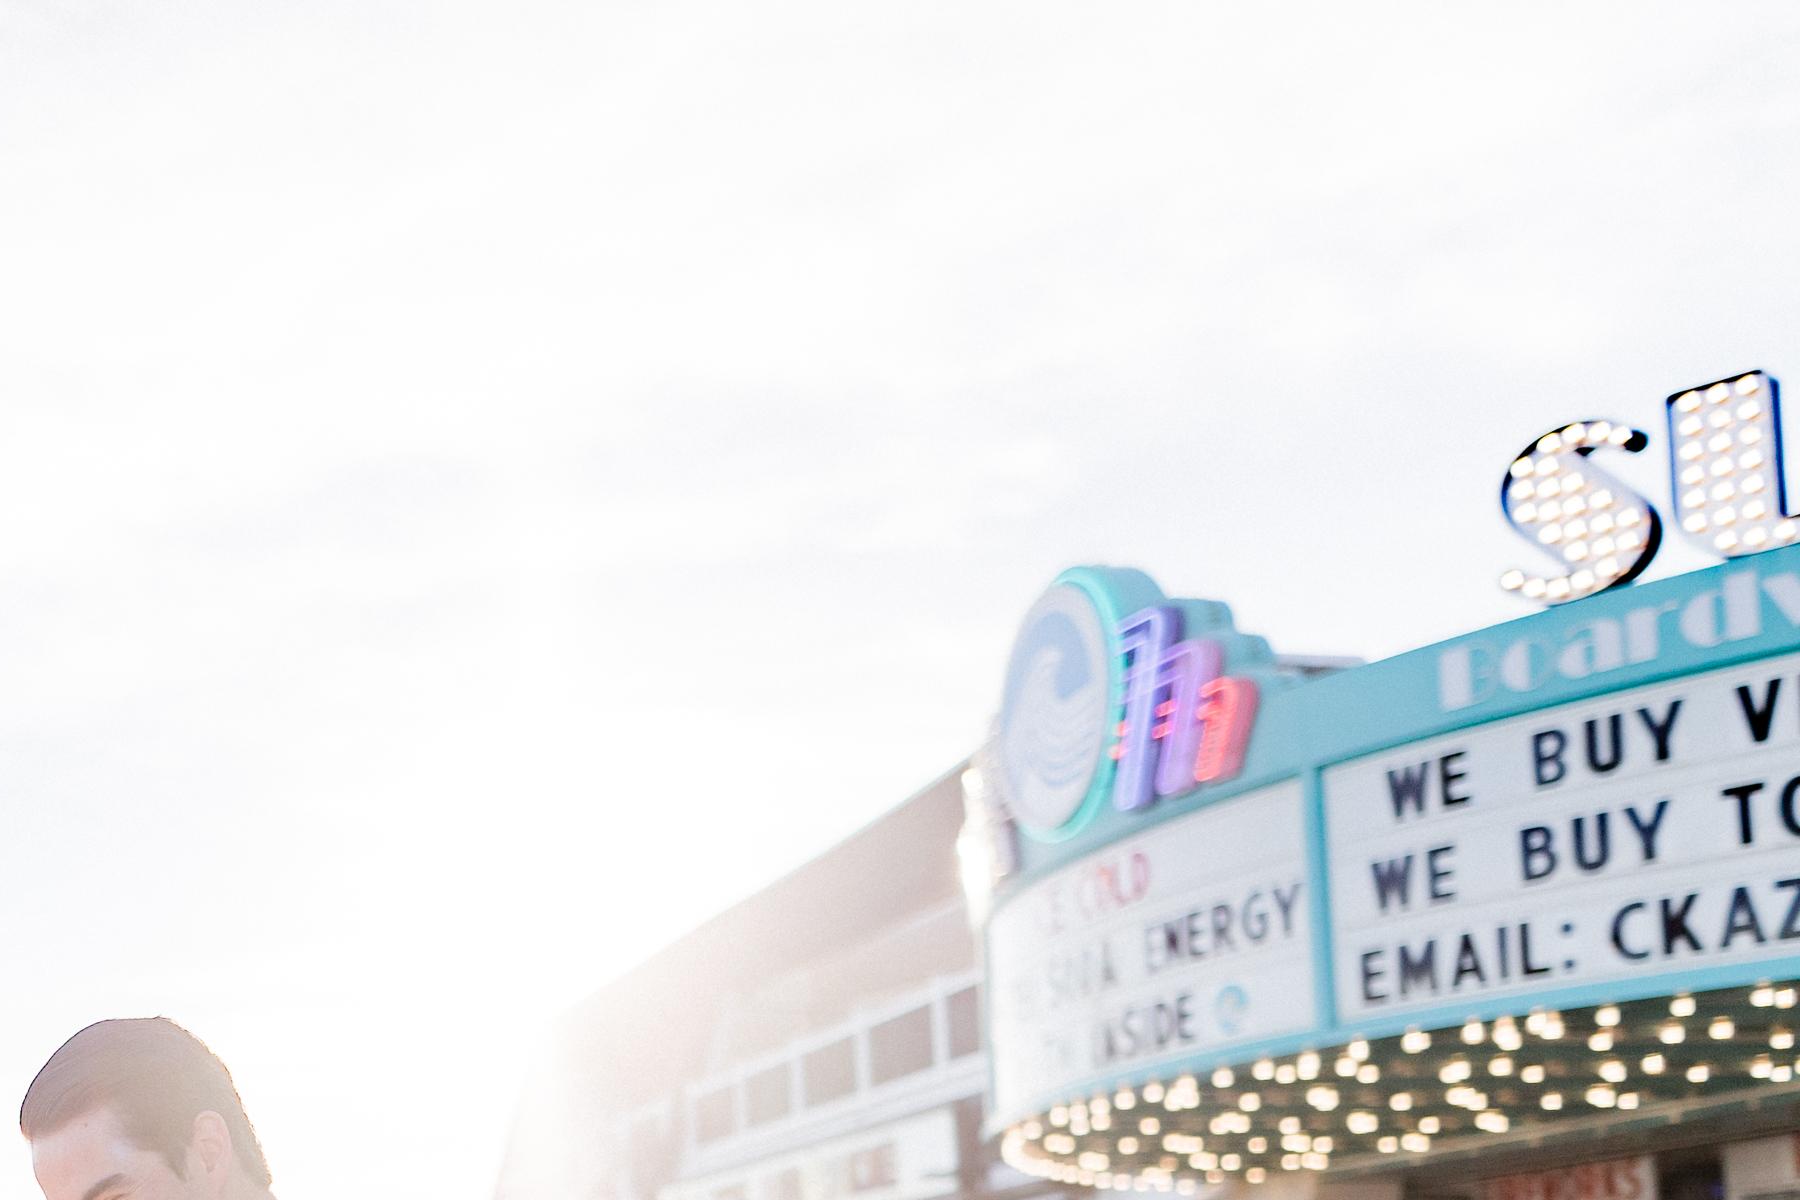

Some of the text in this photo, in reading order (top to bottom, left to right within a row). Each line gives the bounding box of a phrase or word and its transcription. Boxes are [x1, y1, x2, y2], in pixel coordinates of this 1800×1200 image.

[1387, 675, 1800, 823] WE BUY V
[1371, 844, 1457, 911] WE
[1520, 800, 1670, 881] BUY
[1144, 882, 1302, 976] ENERGY
[1360, 878, 1800, 1002] EMAIL: CKAZ
